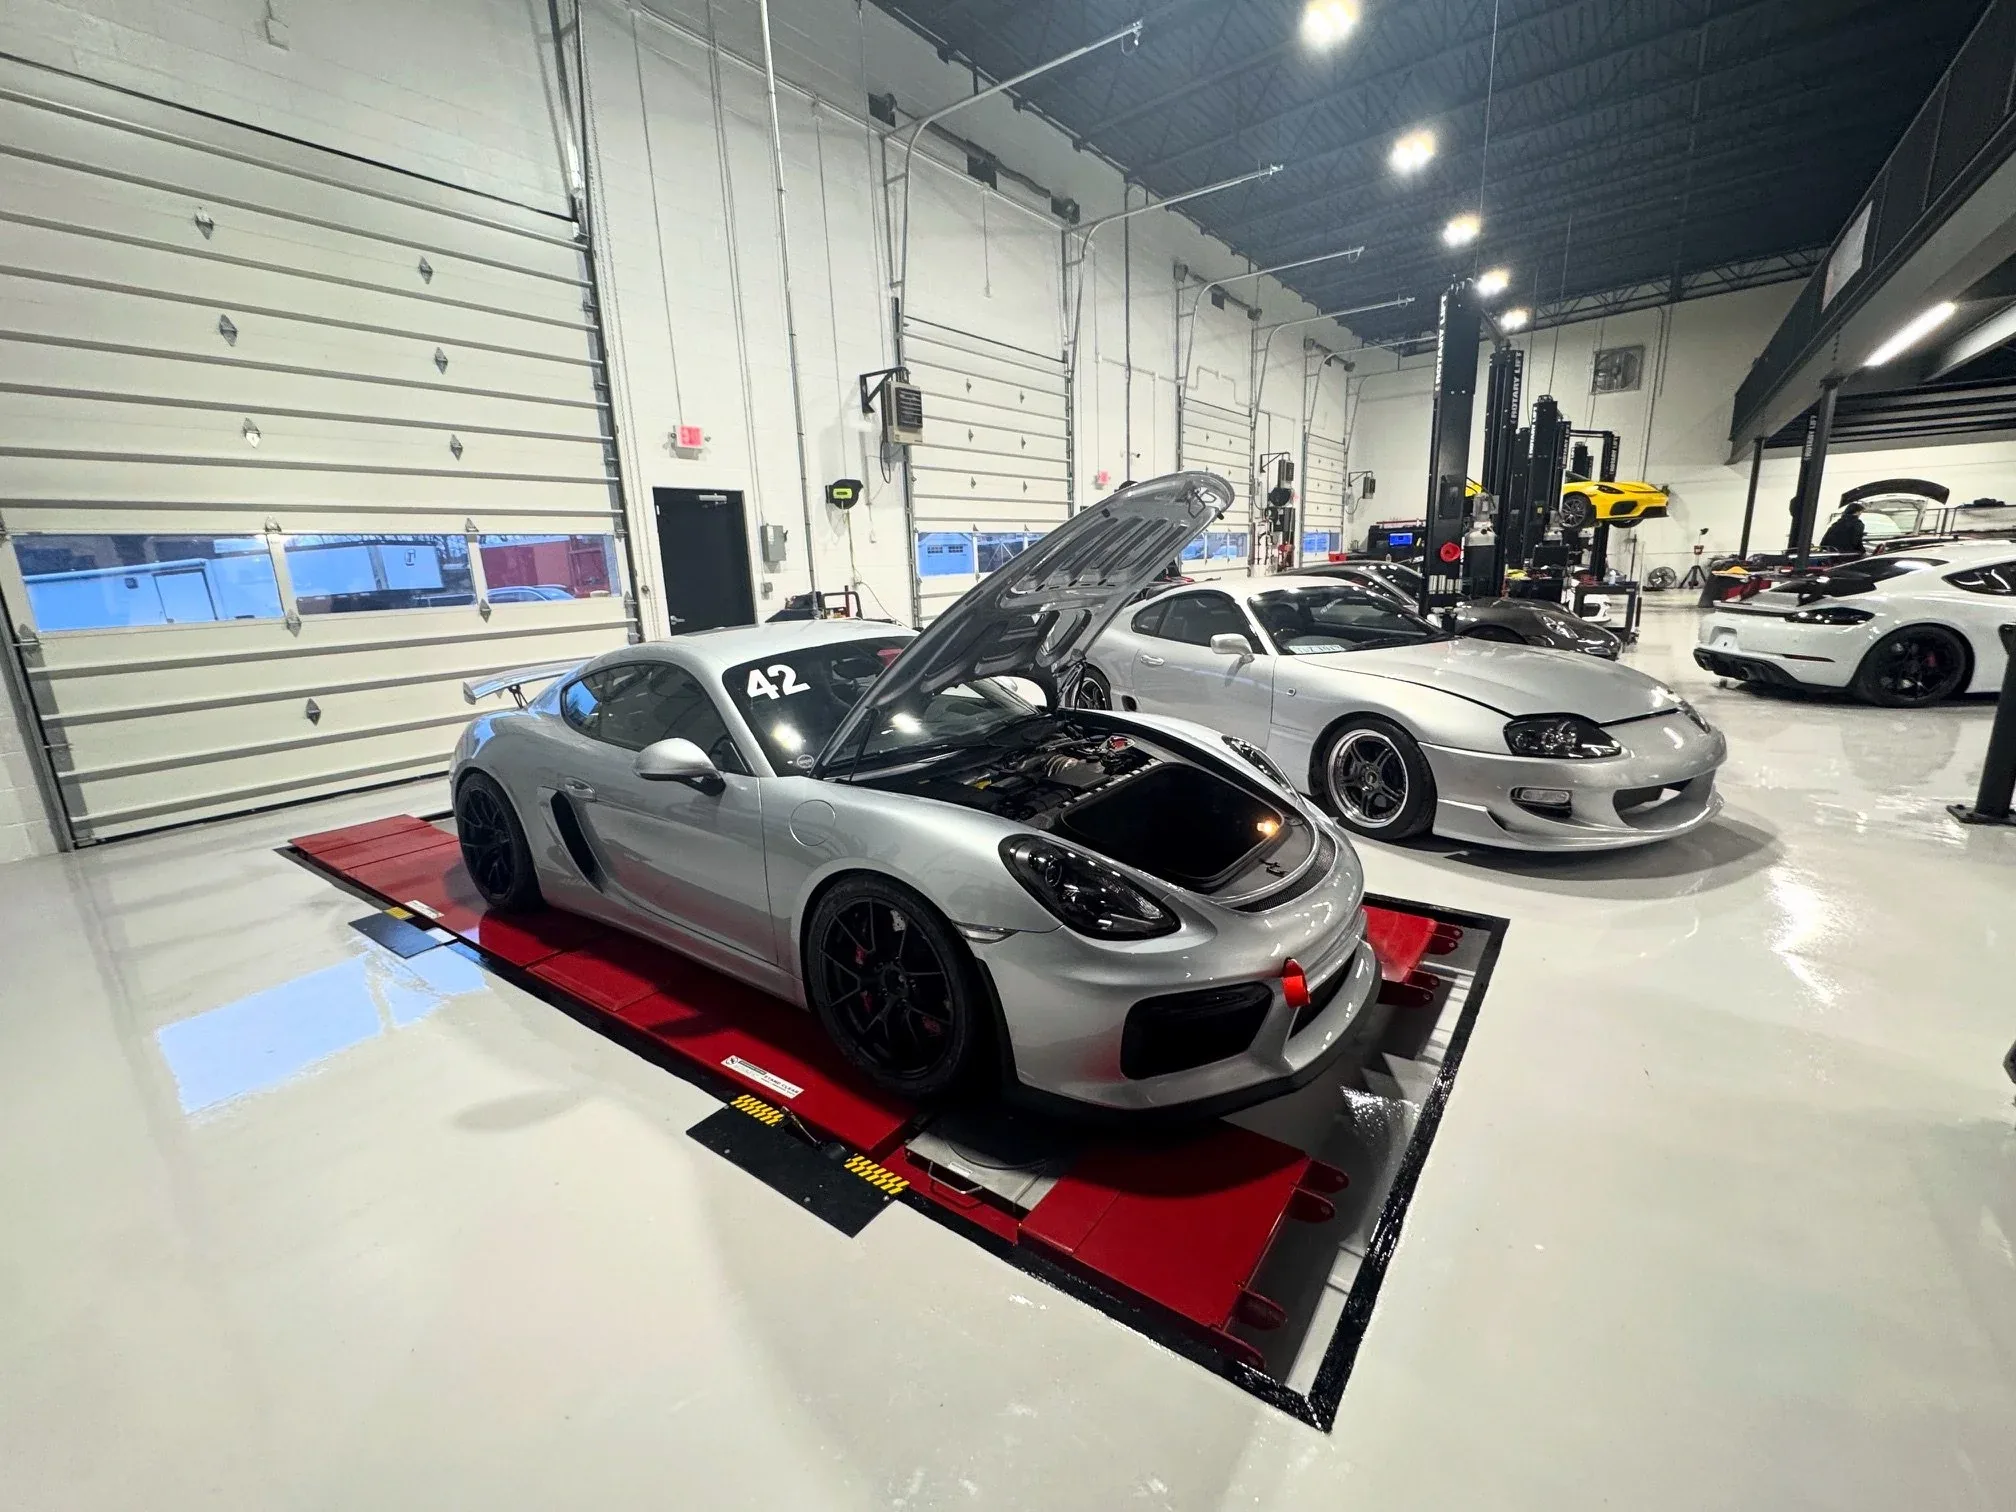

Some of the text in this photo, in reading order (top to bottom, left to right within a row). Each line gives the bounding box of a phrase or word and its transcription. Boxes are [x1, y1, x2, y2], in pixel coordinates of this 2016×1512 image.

[1510, 351, 1522, 420] ROTARY LIFT
[747, 664, 811, 700] 42
